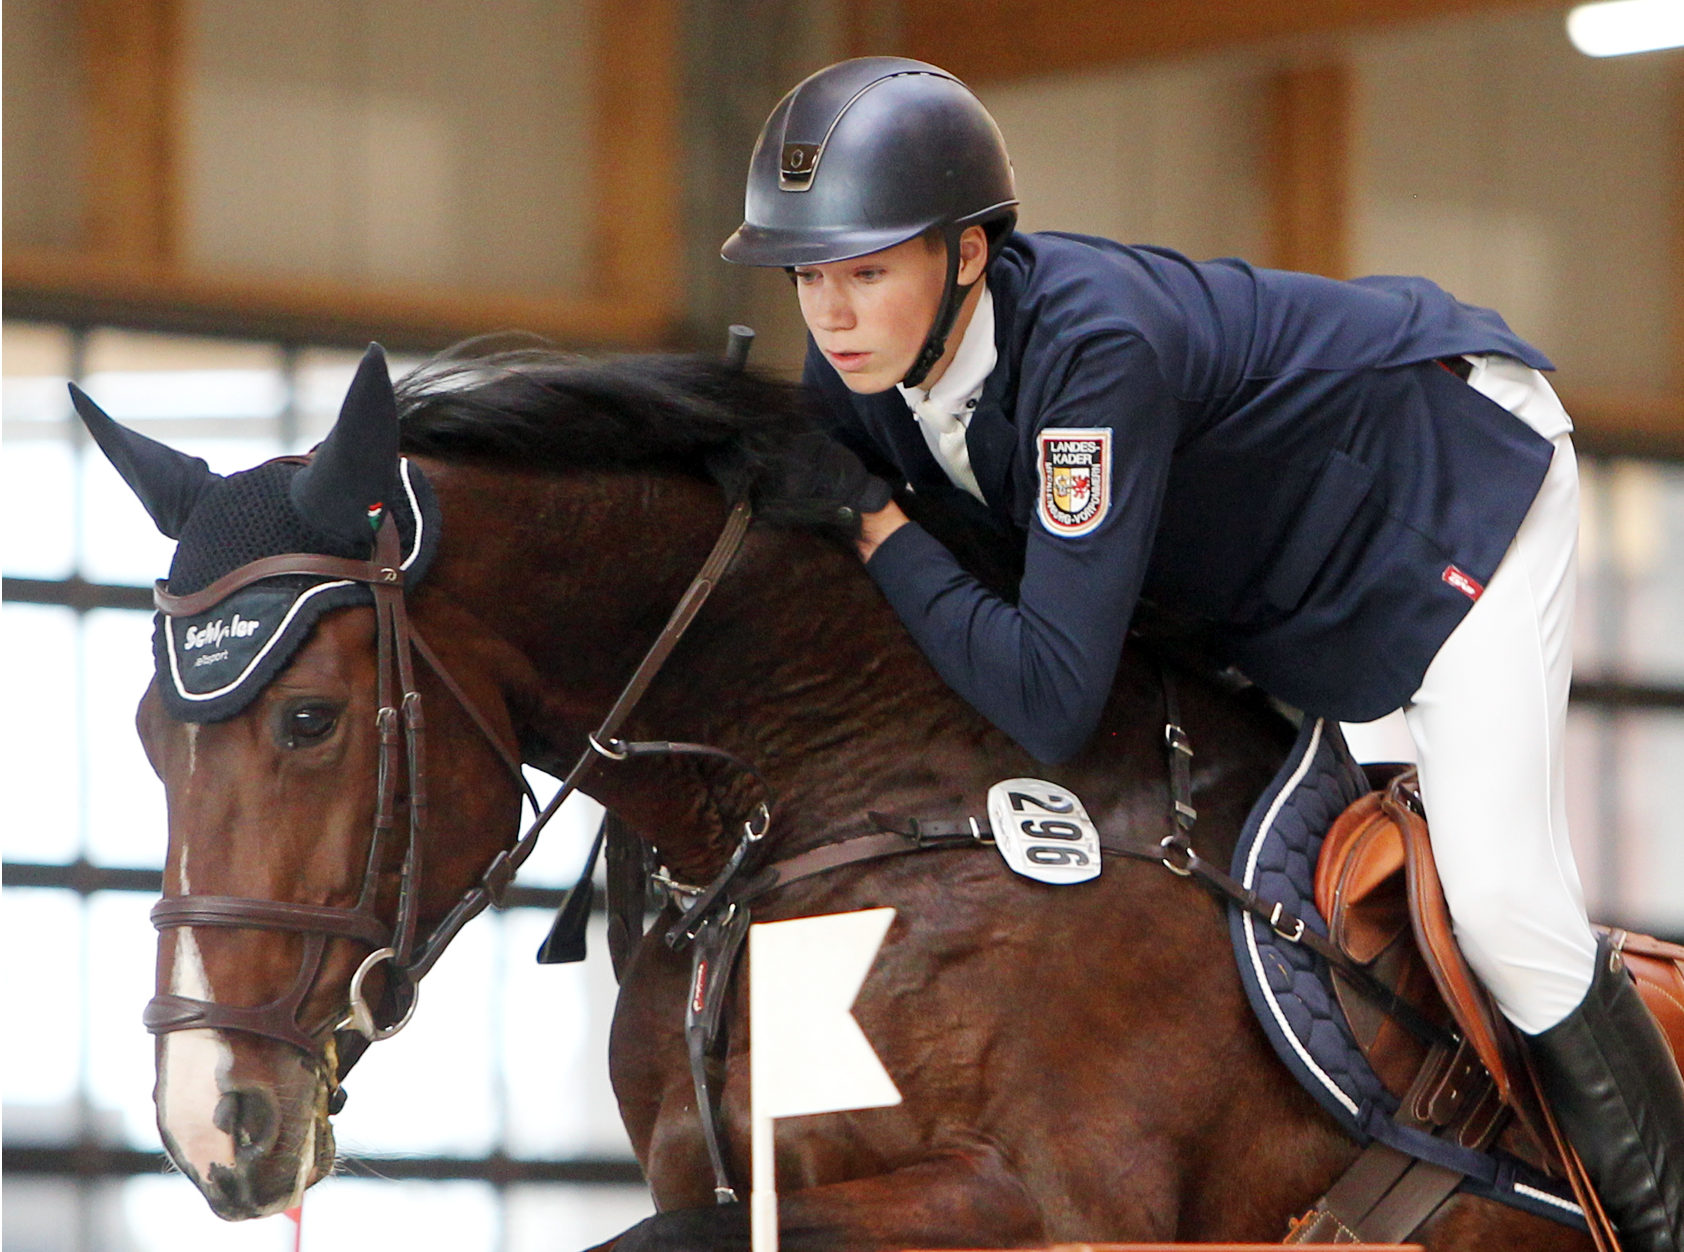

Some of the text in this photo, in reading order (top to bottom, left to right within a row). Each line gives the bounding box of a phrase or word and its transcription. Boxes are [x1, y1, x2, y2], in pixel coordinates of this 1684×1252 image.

[1050, 441, 1101, 453] LANDES-
[1052, 453, 1093, 465] KADER
[1008, 791, 1089, 866] 296
